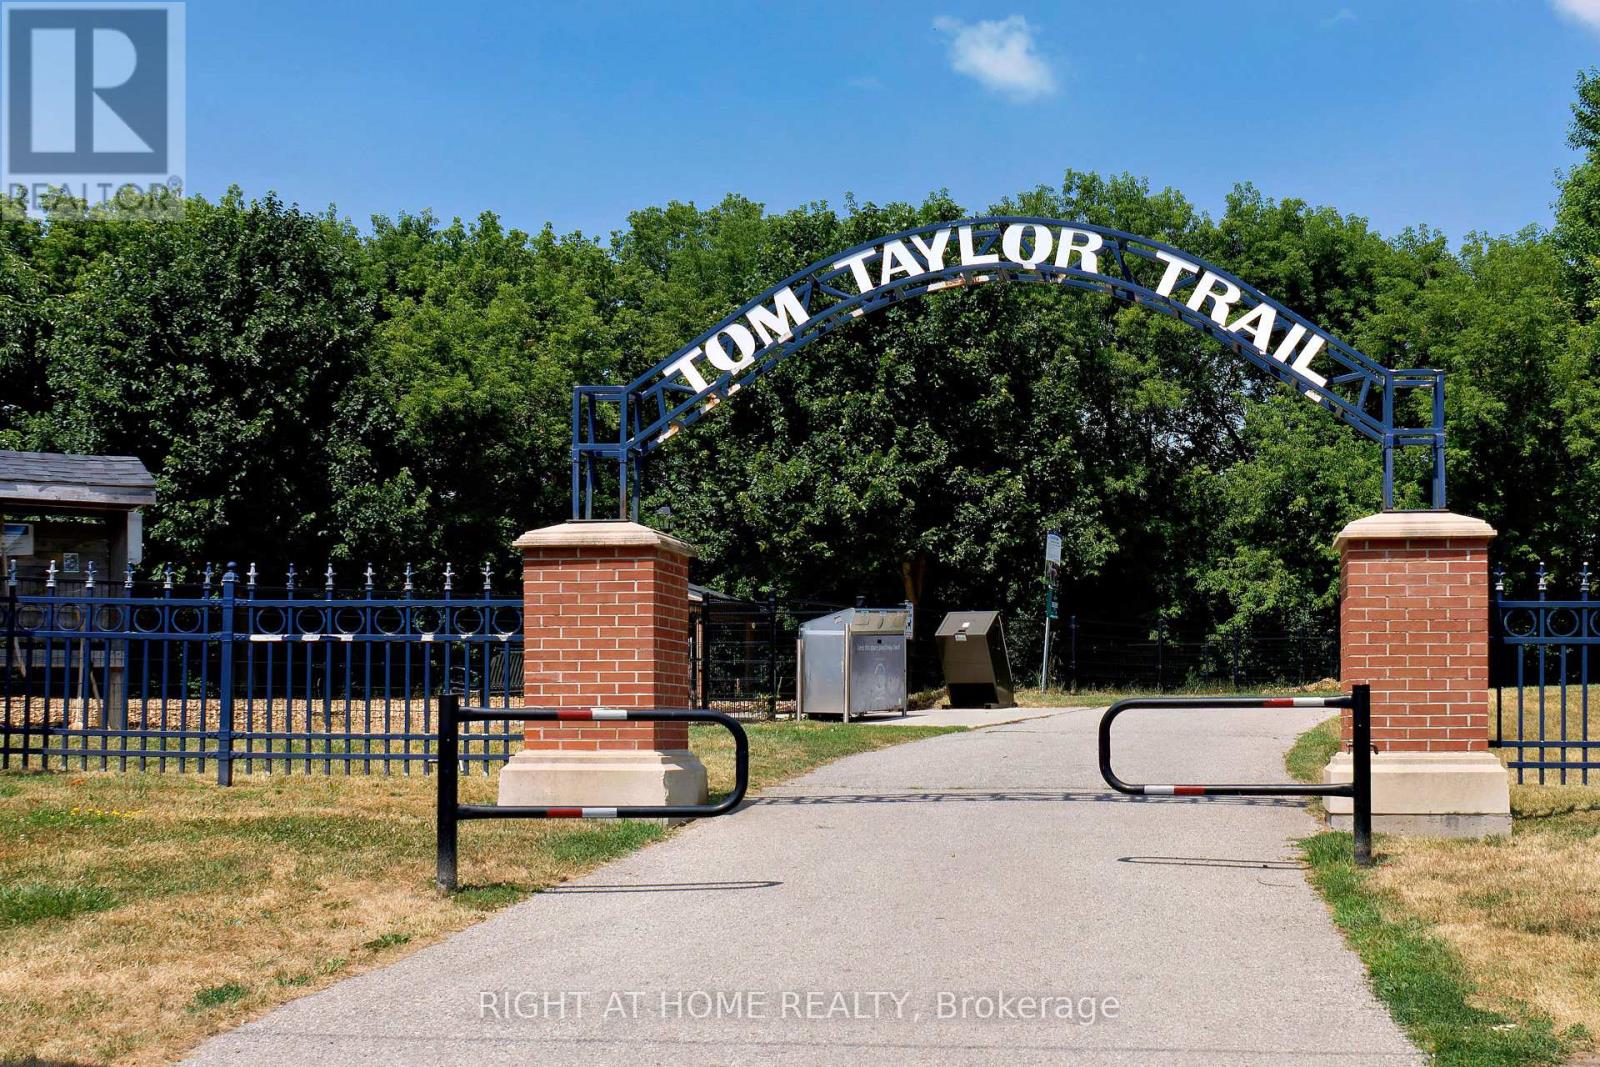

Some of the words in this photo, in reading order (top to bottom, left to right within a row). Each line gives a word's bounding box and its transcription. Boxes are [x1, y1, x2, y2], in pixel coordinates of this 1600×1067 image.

[663, 287, 809, 393] TOM
[833, 223, 1103, 293] TAYLOR
[1156, 251, 1328, 387] TRAIL
